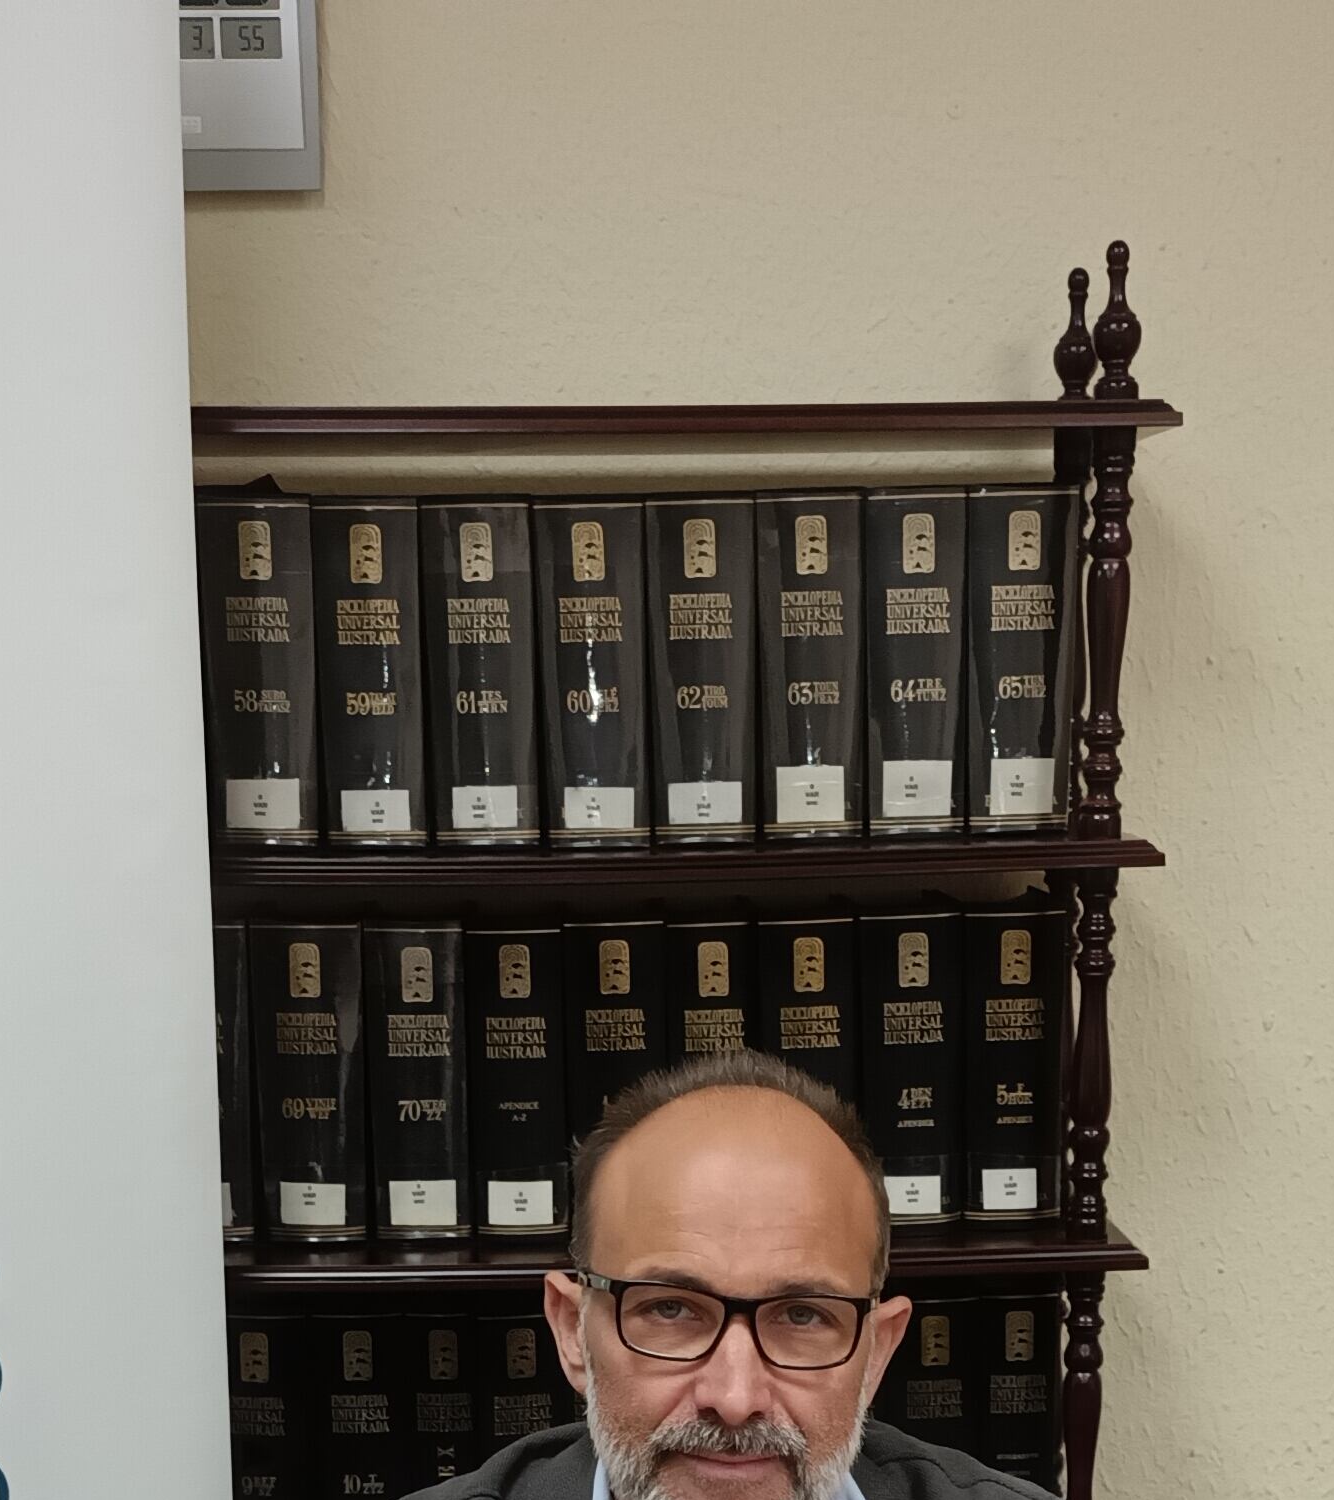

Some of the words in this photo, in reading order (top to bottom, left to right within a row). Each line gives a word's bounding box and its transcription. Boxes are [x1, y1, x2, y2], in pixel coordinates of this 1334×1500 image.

[238, 25, 265, 52] 55
[781, 591, 843, 607] ENCICLOPEDIA
[886, 587, 951, 603] ENCICLOPEDIA
[991, 584, 1055, 600] ENCICLOPEDIA
[226, 597, 290, 612] ENCICLOPEDIA
[336, 599, 401, 614] ENCICLOPEDIA
[447, 598, 511, 613] ENCICLOPEDIA
[558, 597, 623, 613] ENCICLOPEDIA
[668, 593, 733, 609] ENCICLOPEDIA
[991, 599, 1055, 616] UNIVERSAL
[668, 608, 733, 625] UNIVERSAL
[781, 606, 843, 622] UNIVERSAL
[886, 602, 951, 619] UNIVERSAL
[226, 612, 290, 627] UNIVERSAL
[336, 614, 401, 629] UNIVERSAL
[447, 613, 511, 628] UNIVERSAL
[558, 613, 623, 628] UNIVERSAL
[886, 618, 951, 635] ILUSTRADA
[991, 615, 1055, 632] ILUSTRADA
[226, 627, 290, 643] ILUSTRADA
[336, 630, 401, 645] ILUSTRADA
[447, 628, 511, 644] ILUSTRADA
[558, 627, 623, 644] ILUSTRADA
[668, 624, 733, 640] ILUSTRADA
[781, 621, 843, 638] ILUSTRADA
[788, 681, 813, 705] 63
[890, 679, 916, 703] 64
[998, 676, 1024, 700] 65
[234, 690, 259, 713] 58
[346, 692, 370, 716] 59
[456, 691, 478, 715] 61
[567, 690, 592, 714] 60
[677, 686, 702, 710] 62
[780, 1005, 841, 1020] ENCICLOPEDIA
[883, 1000, 944, 1016] ENCICLOPEDIA
[985, 998, 1045, 1013] ENCICLOPEDIA
[275, 1012, 337, 1027] ENCICLOPEDIA
[387, 1014, 451, 1029] ENCICLOPEDIA
[486, 1016, 547, 1031] ENCICLOPEDIA
[585, 1008, 646, 1024] ENCICLOPEDIA
[684, 1009, 745, 1024] ENCICLOPEDIA
[883, 1015, 944, 1031] UNIVERSAL
[985, 1012, 1045, 1028] UNIVERSAL
[275, 1027, 337, 1042] UNIVERSAL
[387, 1028, 451, 1043] UNIVERSAL
[585, 1022, 646, 1038] UNIVERSAL
[684, 1023, 745, 1038] UNIVERSAL
[780, 1020, 841, 1035] UNIVERSAL
[985, 1027, 1045, 1042] ILUSTRADA
[486, 1030, 547, 1045] UNIVERSAL
[585, 1037, 646, 1052] ILUSTRADA
[684, 1037, 745, 1053] ILUSTRADA
[780, 1034, 841, 1050] ILUSTRADA
[883, 1029, 944, 1046] ILUSTRADA
[275, 1041, 337, 1055] ILUSTRADA
[387, 1042, 451, 1058] ILUSTRADA
[486, 1044, 547, 1060] ILUSTRADA
[897, 1088, 911, 1109] 4
[995, 1084, 1009, 1105] 5
[281, 1098, 305, 1120] 69
[398, 1101, 421, 1122] 70
[330, 1394, 389, 1408] ENCICLOPEDIA
[330, 1407, 389, 1421] UNIVERSAL
[330, 1420, 389, 1434] ILUSTRADA
[342, 1474, 361, 1496] 10
